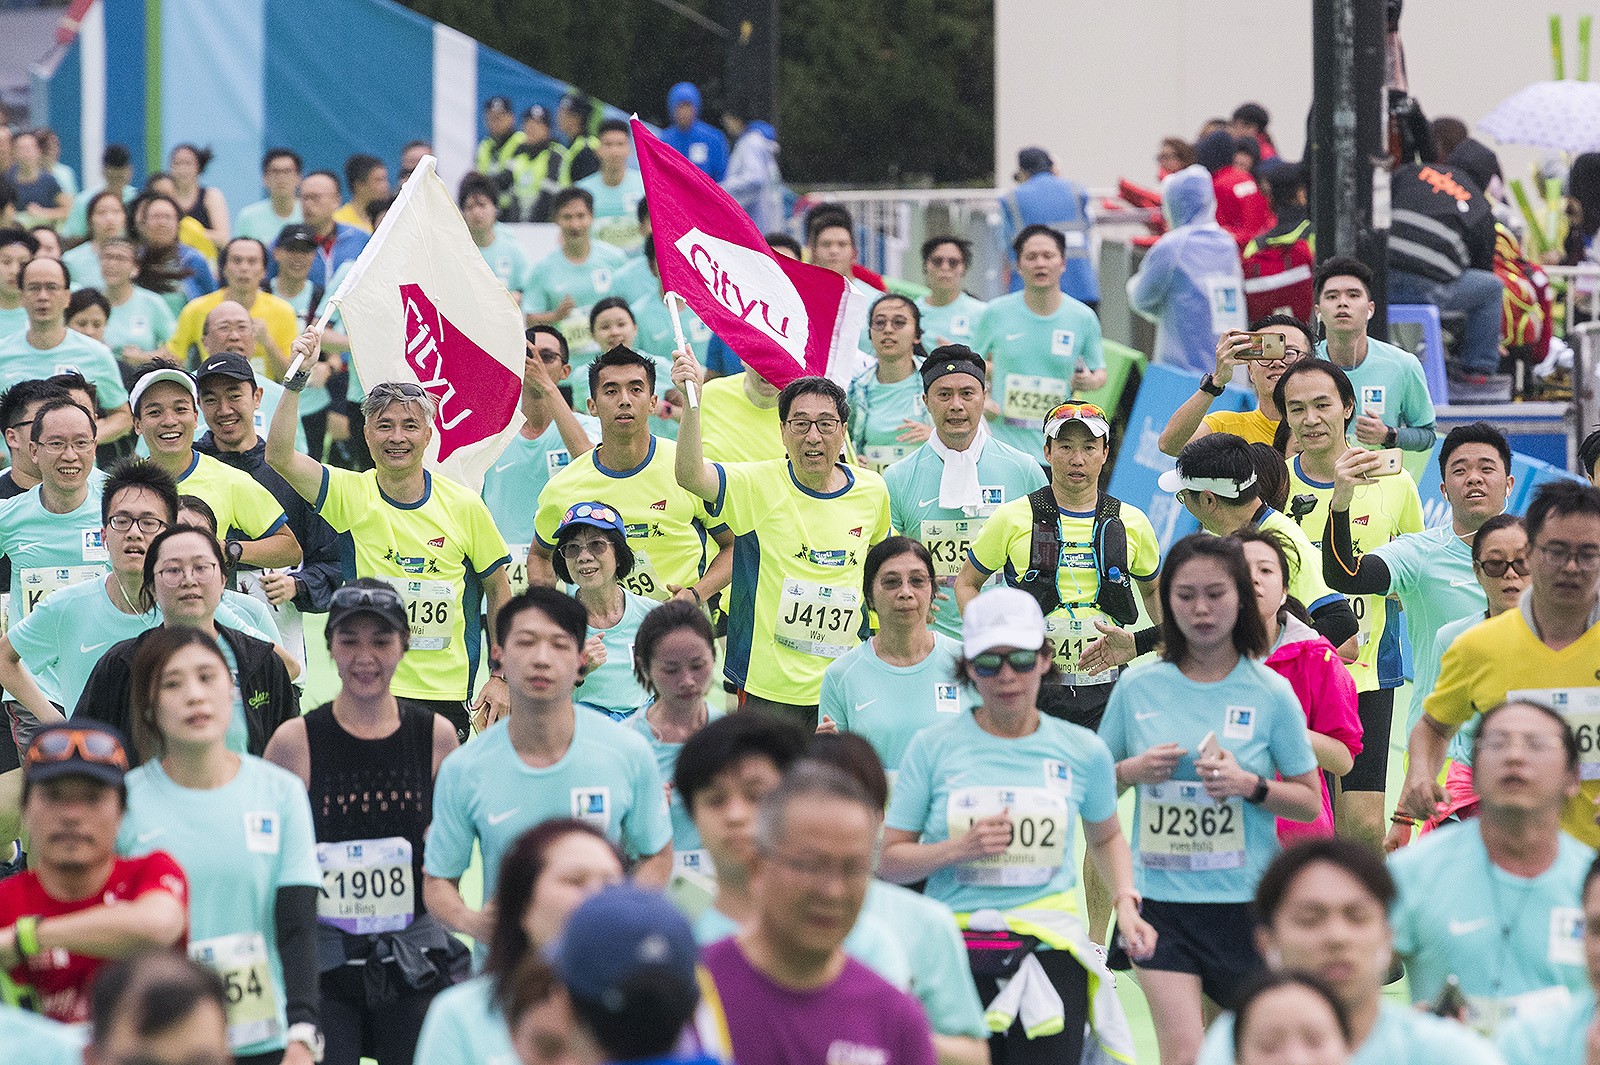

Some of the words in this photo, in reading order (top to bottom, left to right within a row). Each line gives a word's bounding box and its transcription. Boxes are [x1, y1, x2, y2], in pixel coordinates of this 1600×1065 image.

[690, 243, 789, 338] CityU
[404, 297, 473, 431] CityU
[927, 540, 970, 562] K35
[784, 602, 854, 632] J4137
[810, 630, 826, 642] Way
[1150, 806, 1234, 837] J2362
